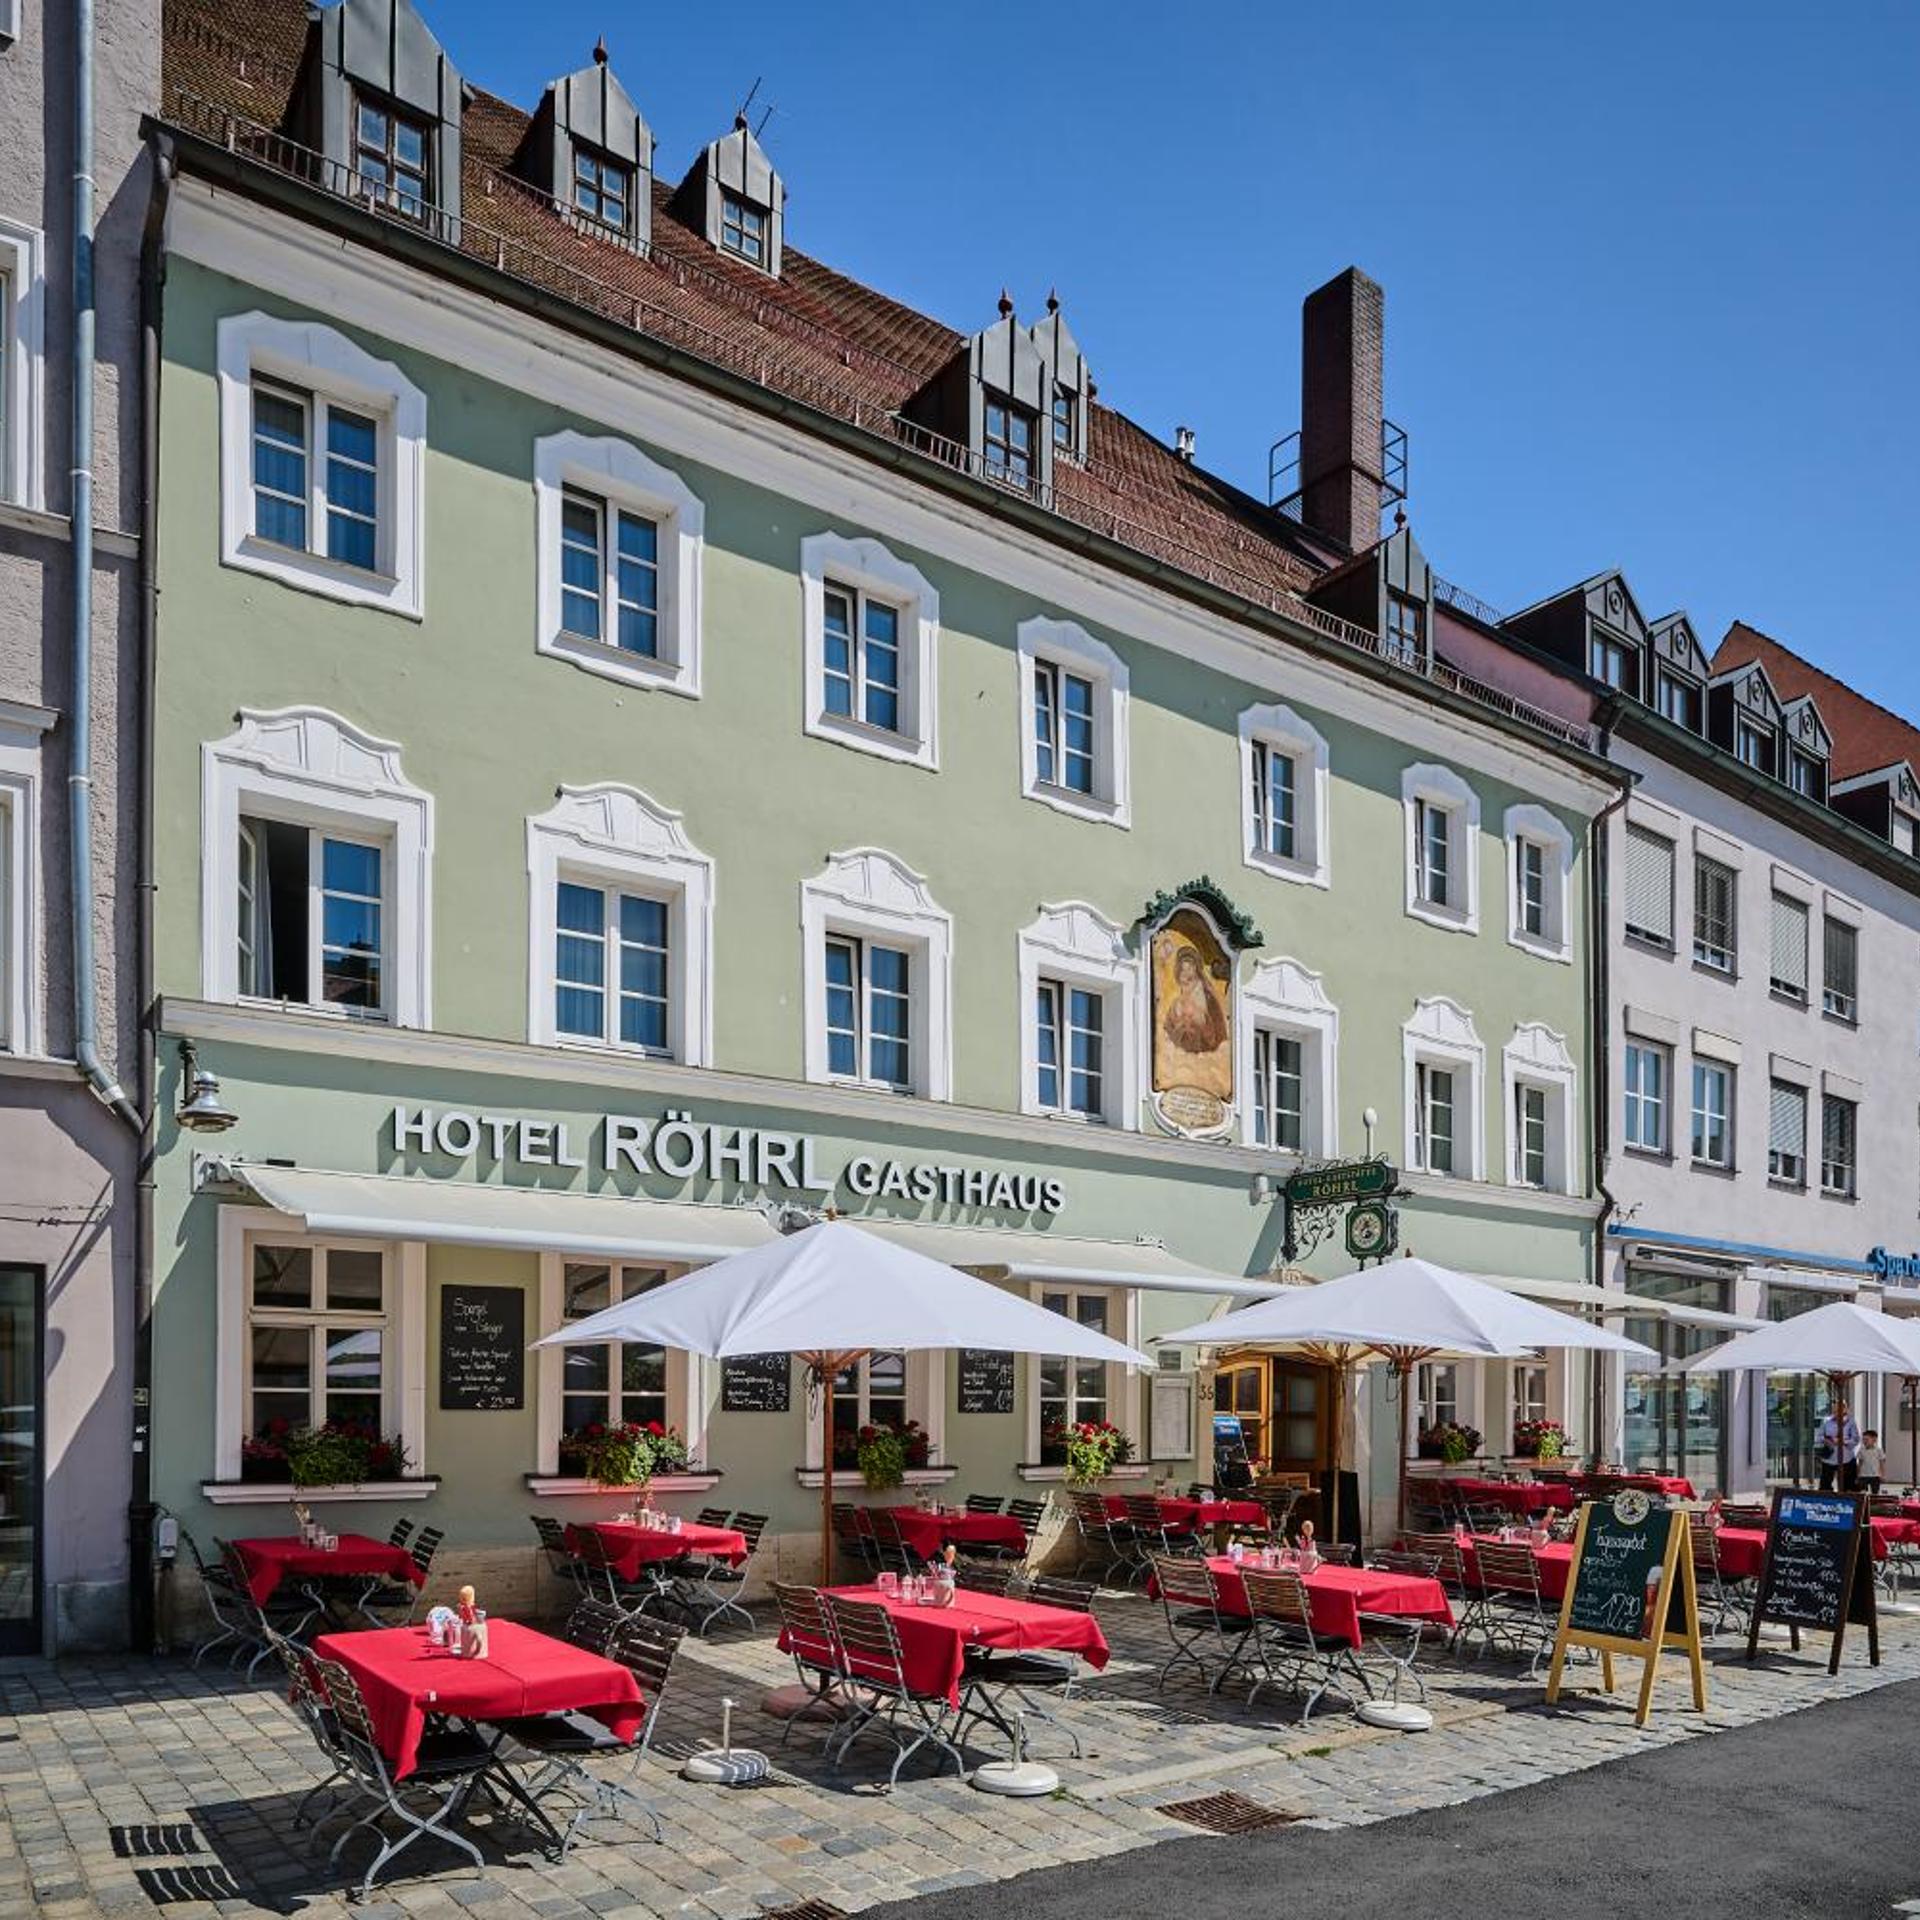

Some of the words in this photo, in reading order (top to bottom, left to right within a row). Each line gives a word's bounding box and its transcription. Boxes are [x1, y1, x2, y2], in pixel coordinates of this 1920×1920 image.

[393, 1103, 586, 1168] HOTEL
[605, 1108, 836, 1192] RÖHRL
[847, 1155, 1067, 1215] GASTHAUS
